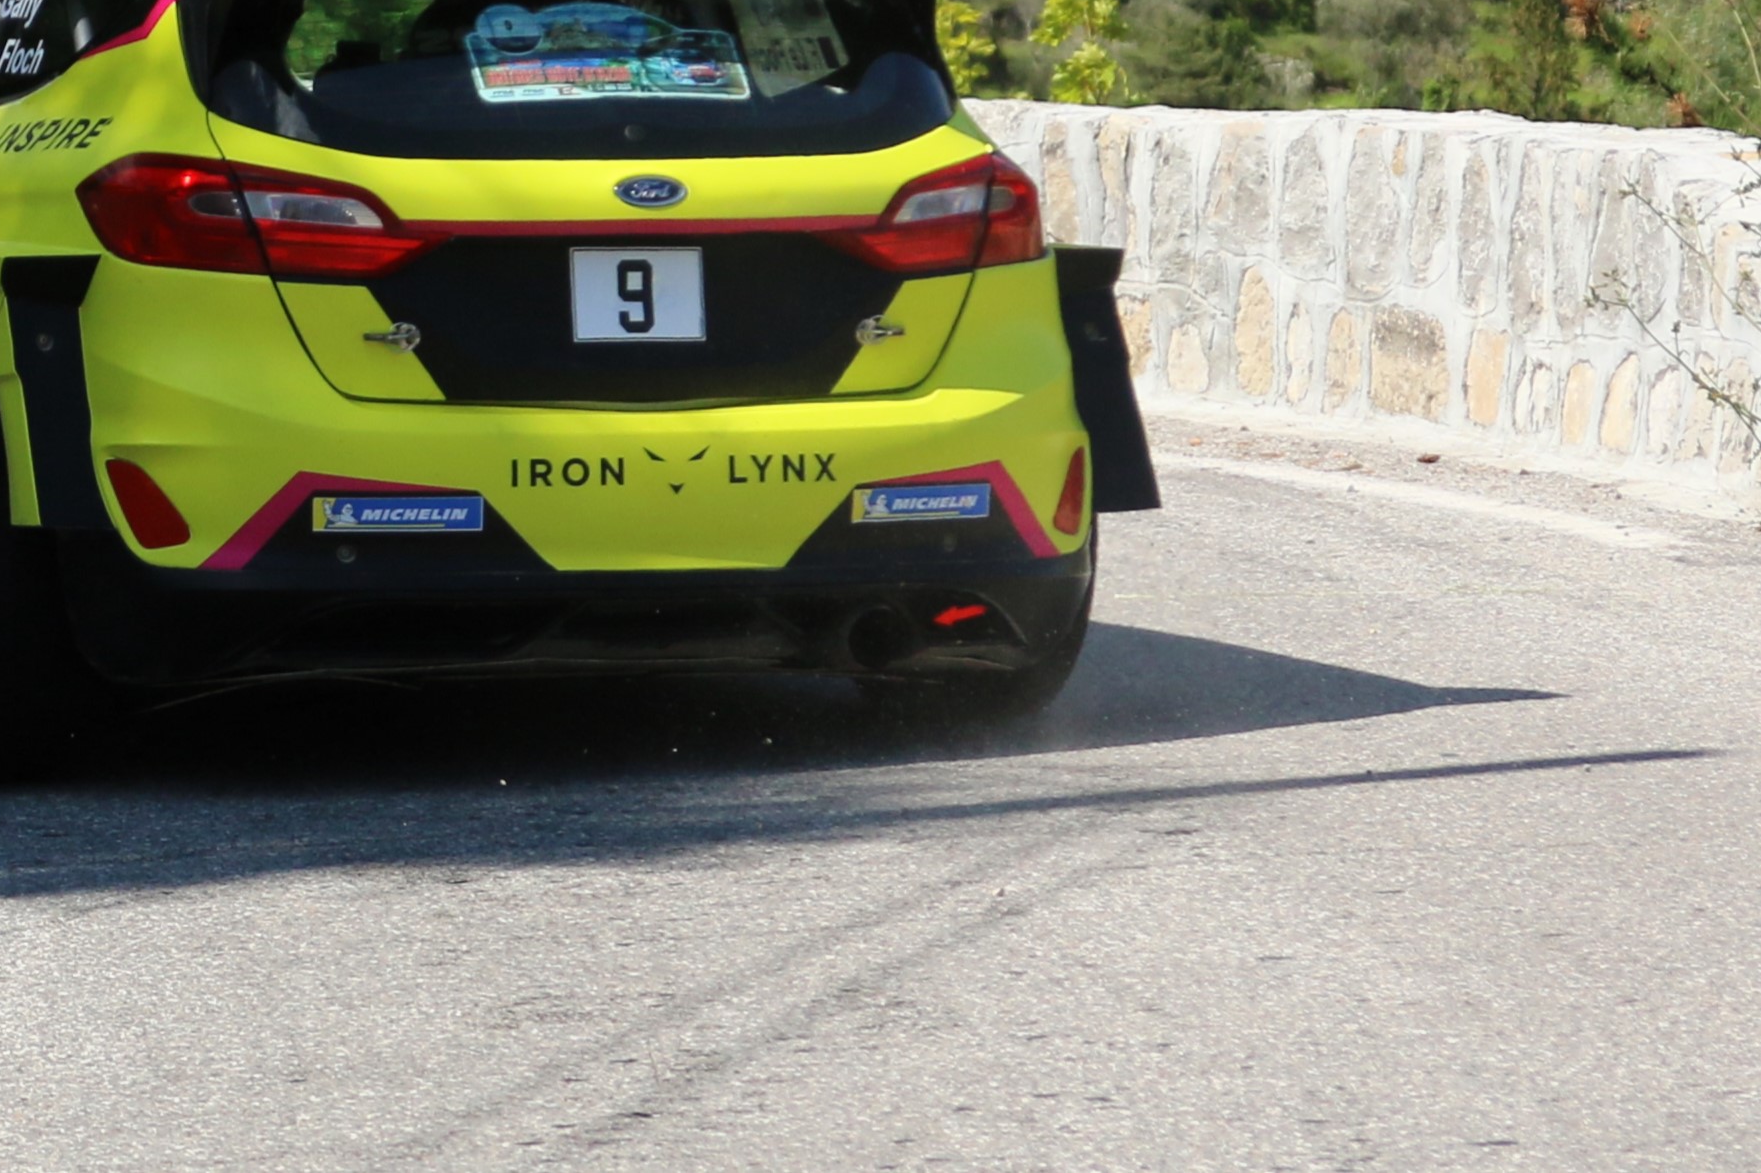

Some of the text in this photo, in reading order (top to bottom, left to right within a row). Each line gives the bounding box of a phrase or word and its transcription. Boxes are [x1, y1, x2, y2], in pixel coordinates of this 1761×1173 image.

[630, 180, 670, 198] Ford
[617, 259, 655, 333] 9
[511, 453, 837, 487] IRON LYNX
[892, 495, 978, 510] MICHELIN
[361, 508, 468, 521] MICHELIN
